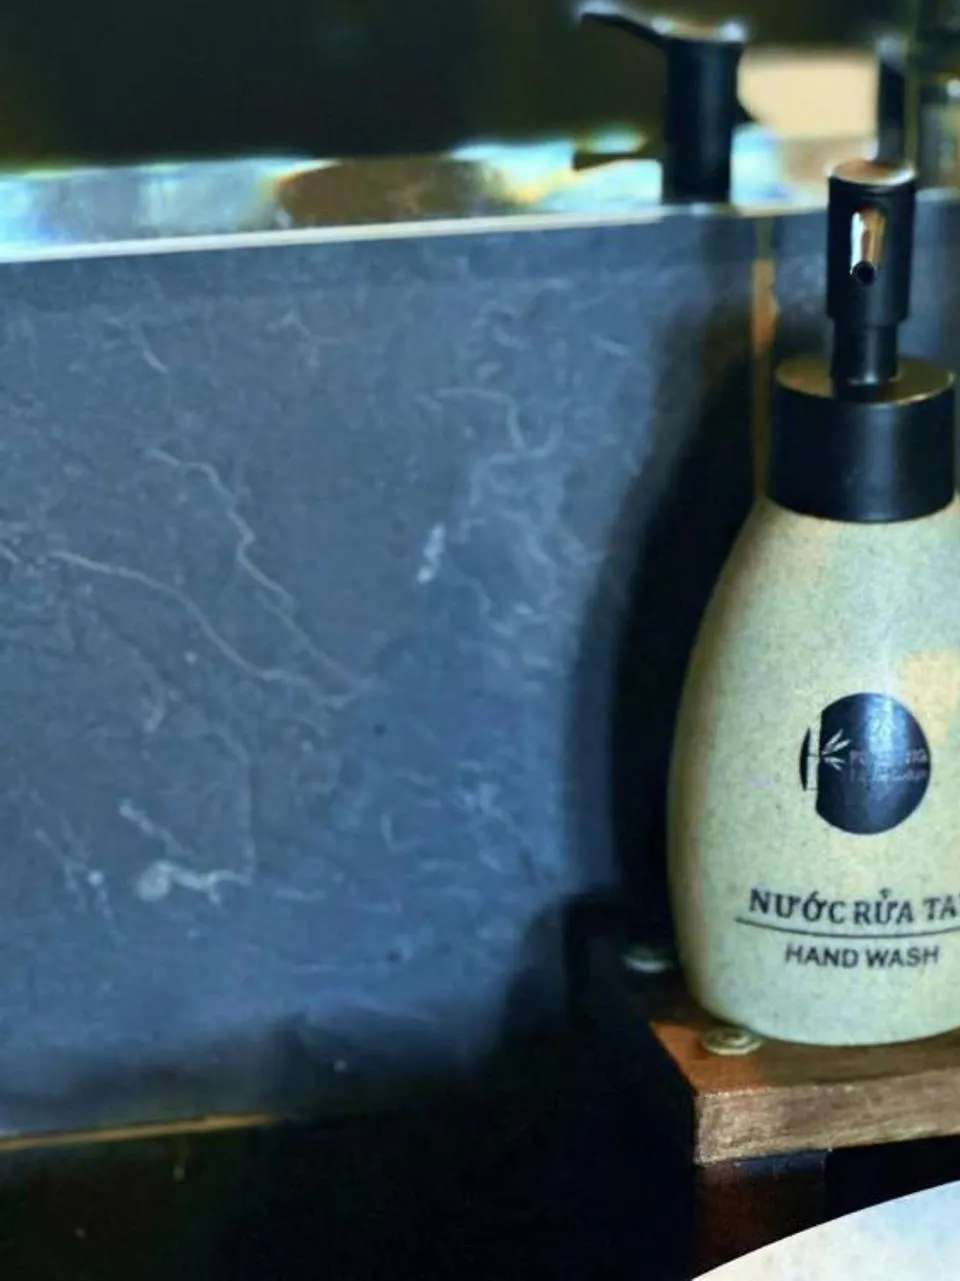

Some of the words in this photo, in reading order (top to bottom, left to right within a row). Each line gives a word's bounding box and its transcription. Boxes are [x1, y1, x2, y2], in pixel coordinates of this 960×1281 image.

[749, 887, 846, 924] NƯỚC
[853, 888, 915, 926] RỬA
[785, 943, 860, 969] HAND
[864, 945, 940, 968] WASH
